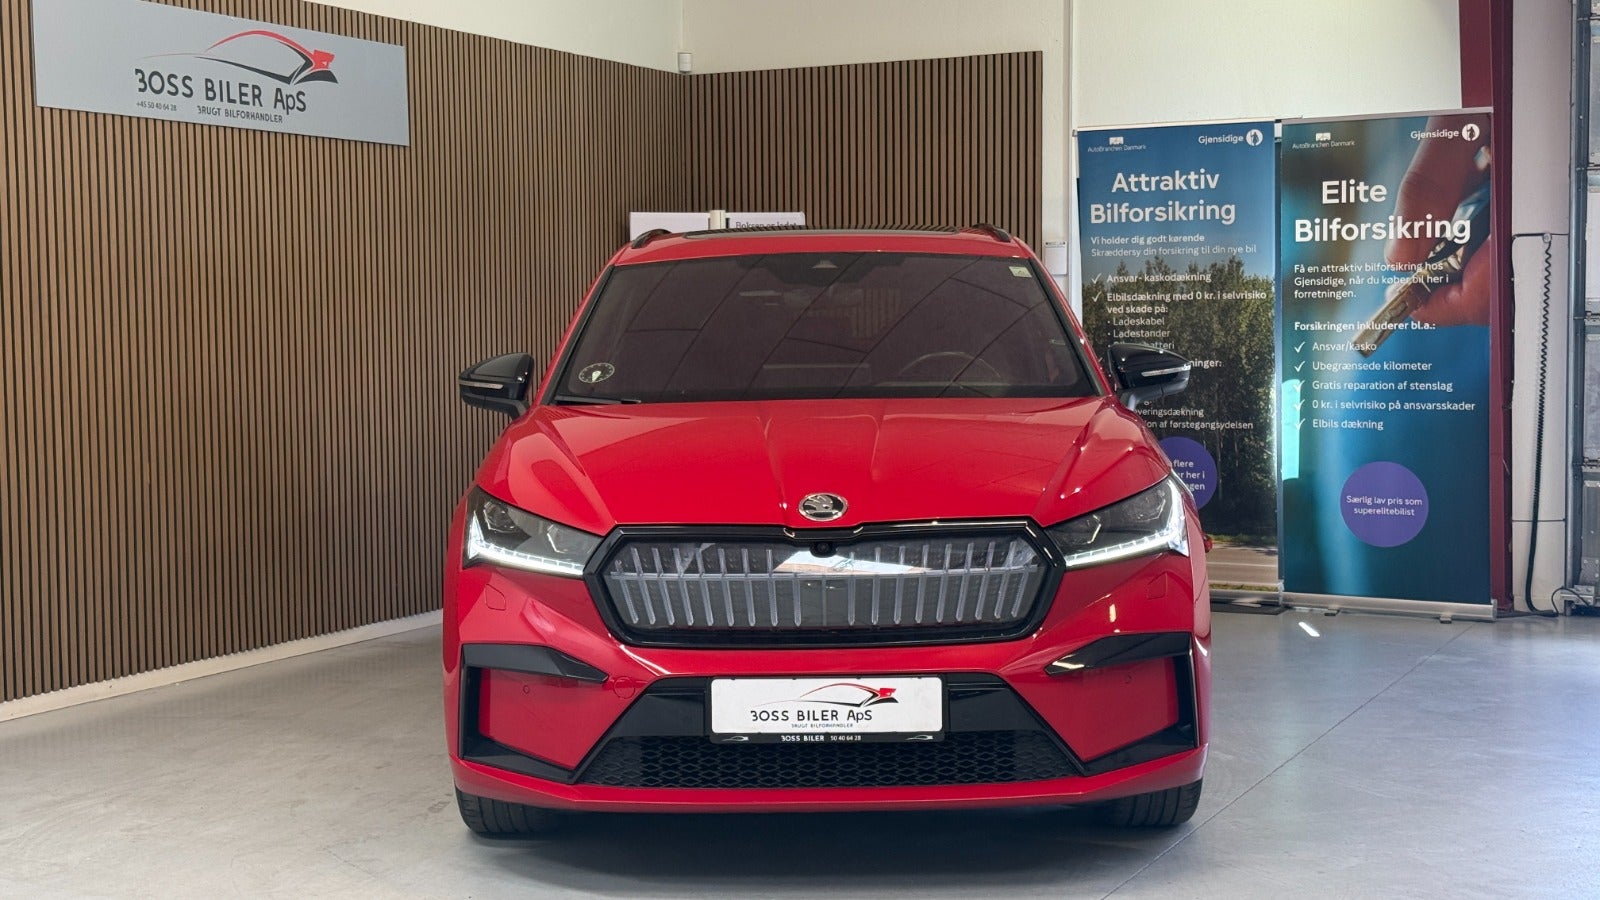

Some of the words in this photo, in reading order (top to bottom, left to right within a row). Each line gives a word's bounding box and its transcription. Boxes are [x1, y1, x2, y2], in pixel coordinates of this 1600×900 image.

[204, 78, 263, 108] BILER
[273, 88, 307, 115] ApS
[225, 110, 283, 123] BILFORHANDLER
[1198, 135, 1244, 144] Gjensidige
[1410, 130, 1459, 140] Gjensidige
[1111, 168, 1220, 192] Attraktiv
[1322, 179, 1388, 204] Elite
[1090, 200, 1236, 225] Bilforsikring
[1295, 214, 1471, 244] Bilforsikring
[1090, 236, 1099, 245] Vi
[1100, 236, 1129, 244] holder
[1131, 235, 1145, 246] dig
[1146, 235, 1166, 246] godt
[1168, 234, 1205, 243] kørende
[1091, 248, 1141, 258] Skræddersy
[1143, 247, 1157, 256] din
[1158, 246, 1199, 257] forsikring
[1201, 246, 1210, 254] til
[1212, 245, 1225, 254] din
[1227, 246, 1242, 255] nye
[1245, 245, 1256, 253] bil
[1294, 263, 1305, 273] Få
[1307, 265, 1319, 273] en
[1321, 263, 1363, 272] attraktiv
[1364, 262, 1423, 272] bilforsikring
[1425, 261, 1443, 270] hos
[1107, 274, 1142, 283] Ansvar-
[1144, 273, 1211, 283] kaskodækning
[1294, 276, 1347, 287] Gjensidige,
[1349, 275, 1364, 285] når
[1367, 275, 1379, 284] du
[1382, 275, 1410, 284] køber
[1412, 274, 1424, 284] bil
[1426, 274, 1443, 283] her
[1107, 292, 1171, 303] Elbilsdækning
[1173, 291, 1193, 300] med
[1204, 291, 1216, 300] kr.
[1222, 291, 1267, 299] selvrisiko
[1294, 289, 1357, 300] forretningen.
[1107, 305, 1124, 314] ved
[1125, 305, 1152, 314] skade
[1154, 304, 1168, 315] på:
[1113, 317, 1164, 326] Ladeskabel
[1294, 321, 1355, 332] Forsikringen
[1357, 321, 1408, 331] inkluderer
[1113, 329, 1170, 338] Ladestander
[1312, 341, 1376, 352] Ansvar/kasko
[1312, 361, 1381, 372] Ubegrænsede
[1383, 361, 1432, 370] kilometer
[1312, 380, 1341, 390] Gratis
[1344, 381, 1395, 392] reparation
[1398, 381, 1408, 390] af
[1410, 381, 1453, 392] stenslag
[1312, 401, 1318, 409] 0
[1321, 401, 1333, 410] kr.
[1340, 401, 1386, 410] selvrisiko
[1388, 400, 1401, 412] på
[1403, 401, 1476, 411] ansvarsskader
[1159, 420, 1167, 428] af
[1170, 421, 1254, 430] førstegangsydelsen
[1312, 419, 1338, 428] Elbils
[1341, 420, 1384, 430] dækning
[1346, 495, 1372, 505] Særlig
[1374, 496, 1386, 504] lav
[1388, 496, 1403, 506] pris
[1354, 506, 1415, 517] superelitebilist
[797, 710, 839, 721] BILER
[847, 709, 872, 723] ApS
